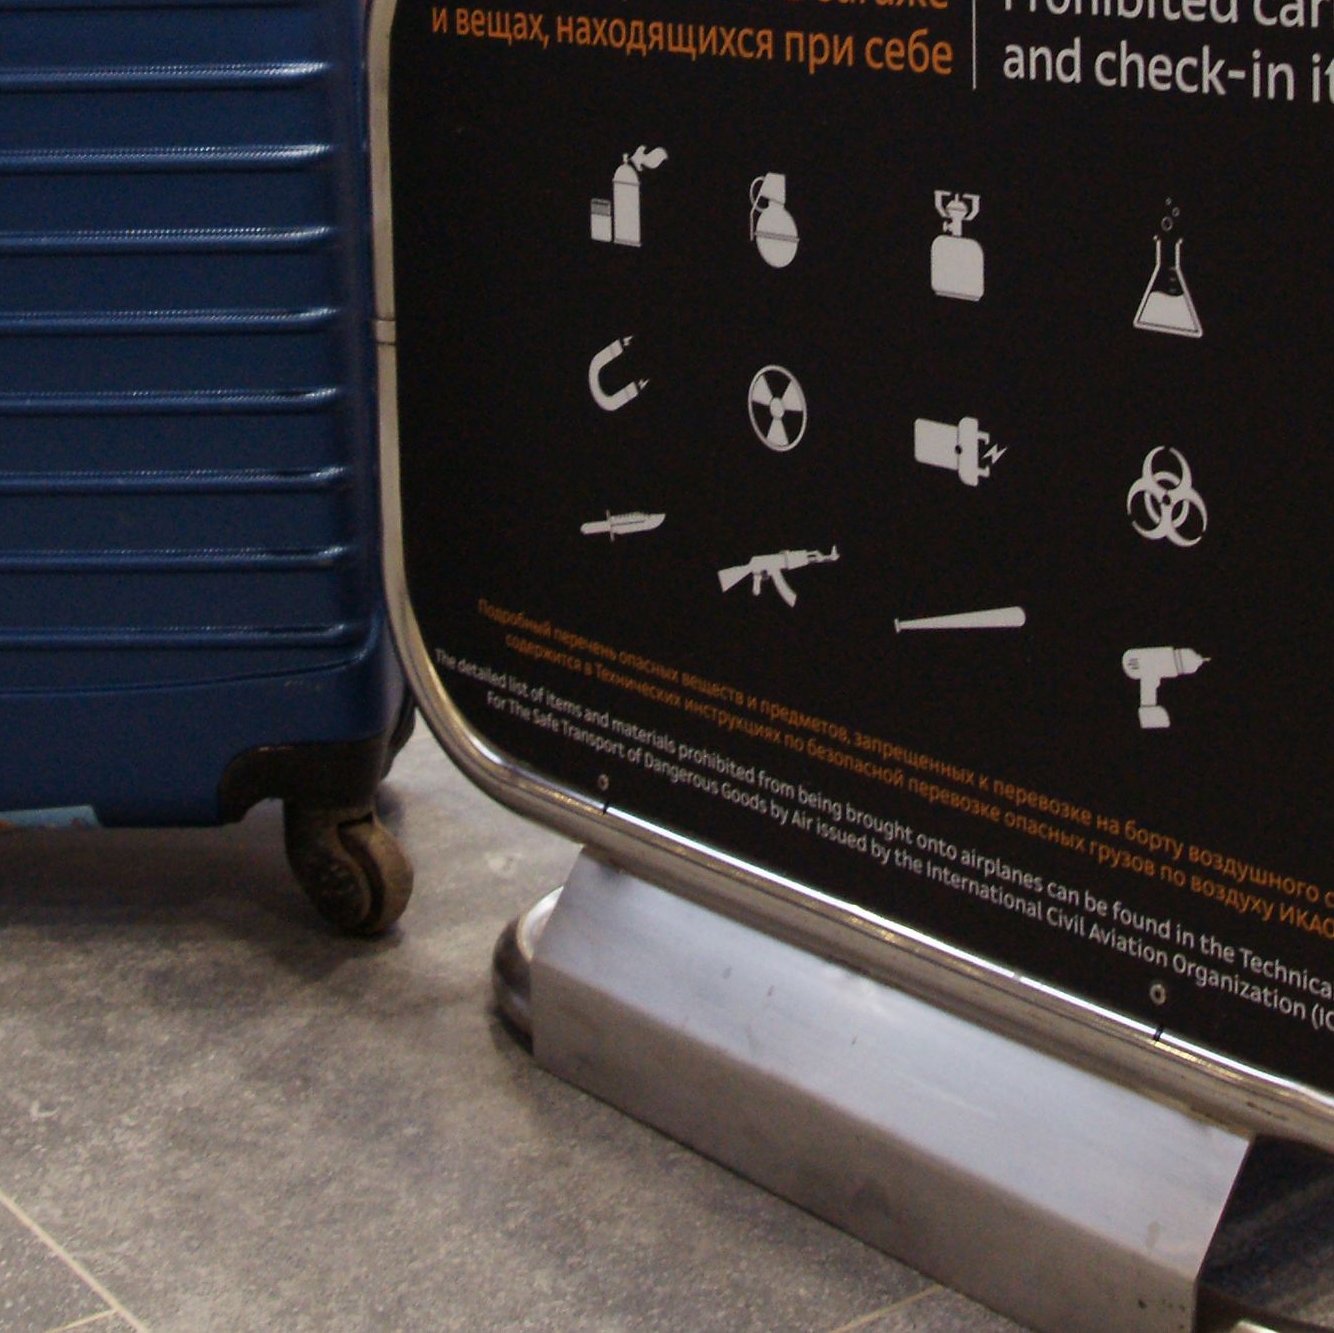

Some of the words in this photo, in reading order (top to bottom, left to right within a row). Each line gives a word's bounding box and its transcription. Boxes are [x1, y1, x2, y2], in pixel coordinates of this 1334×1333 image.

[433, 8, 447, 33] и
[456, 8, 549, 48] вещах,
[557, 15, 773, 60] находящихся
[786, 31, 853, 75] при
[865, 28, 953, 75] себе
[1003, 37, 1081, 84] and
[1095, 39, 1294, 101] check-in
[561, 718, 626, 760] Transport
[625, 746, 642, 764] of
[642, 750, 719, 796] Dangerous
[720, 781, 767, 815] Goods
[769, 798, 789, 827] by
[789, 809, 813, 832] Air
[816, 816, 867, 854] issued
[869, 837, 892, 867] by
[893, 847, 923, 876] the
[925, 859, 1043, 922] International
[1045, 905, 1086, 938] Civil
[1086, 922, 1168, 969] Aviation
[1170, 952, 1306, 1021] Organization
[611, 718, 676, 756] materials
[677, 743, 755, 785] prohibited
[756, 769, 795, 800] from
[797, 783, 842, 823] being
[844, 801, 914, 846] brought
[915, 832, 958, 862] onto
[959, 847, 1043, 894] airplanes
[1046, 880, 1080, 907] can
[1083, 888, 1108, 918] be
[1111, 899, 1169, 941] found
[1174, 922, 1195, 950] in
[1198, 932, 1235, 965] the
[683, 698, 781, 744] инструкциях
[782, 733, 804, 753] по
[806, 738, 904, 787] безопасной
[907, 777, 1000, 823] перевозке
[1003, 811, 1085, 852] опасных
[1088, 840, 1156, 878] грузов
[1159, 864, 1186, 888] по
[1190, 874, 1275, 922] воздуху
[746, 696, 757, 710] и
[852, 731, 975, 786] запрещенных
[978, 775, 989, 791] к
[992, 779, 1093, 827] перевозке
[1096, 814, 1120, 836] на
[1123, 819, 1184, 862] борту
[1187, 844, 1320, 904] воздушного
